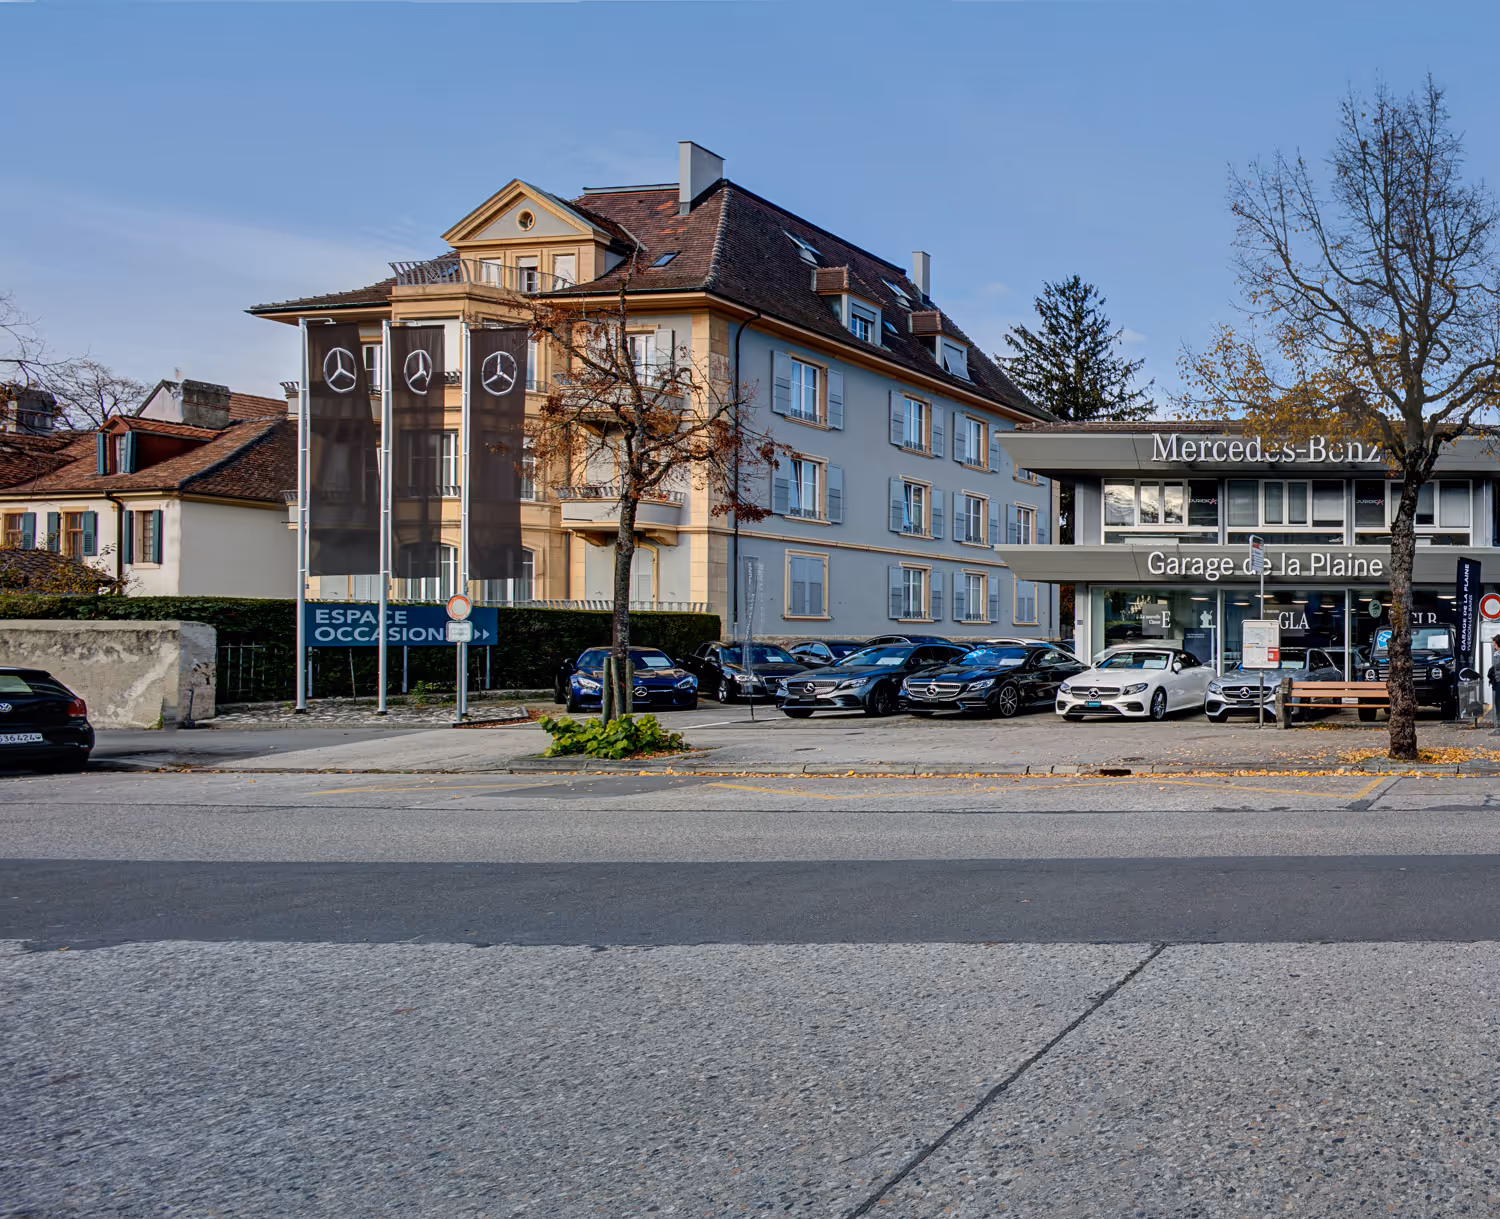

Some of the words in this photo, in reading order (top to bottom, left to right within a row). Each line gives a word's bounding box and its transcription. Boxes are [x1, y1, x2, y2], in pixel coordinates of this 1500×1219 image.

[1151, 433, 1382, 463] Mercedes-Benz
[1147, 551, 1234, 581] Garage
[1281, 552, 1300, 576] la
[1310, 552, 1383, 577] Plaine
[1279, 611, 1310, 630] GLA
